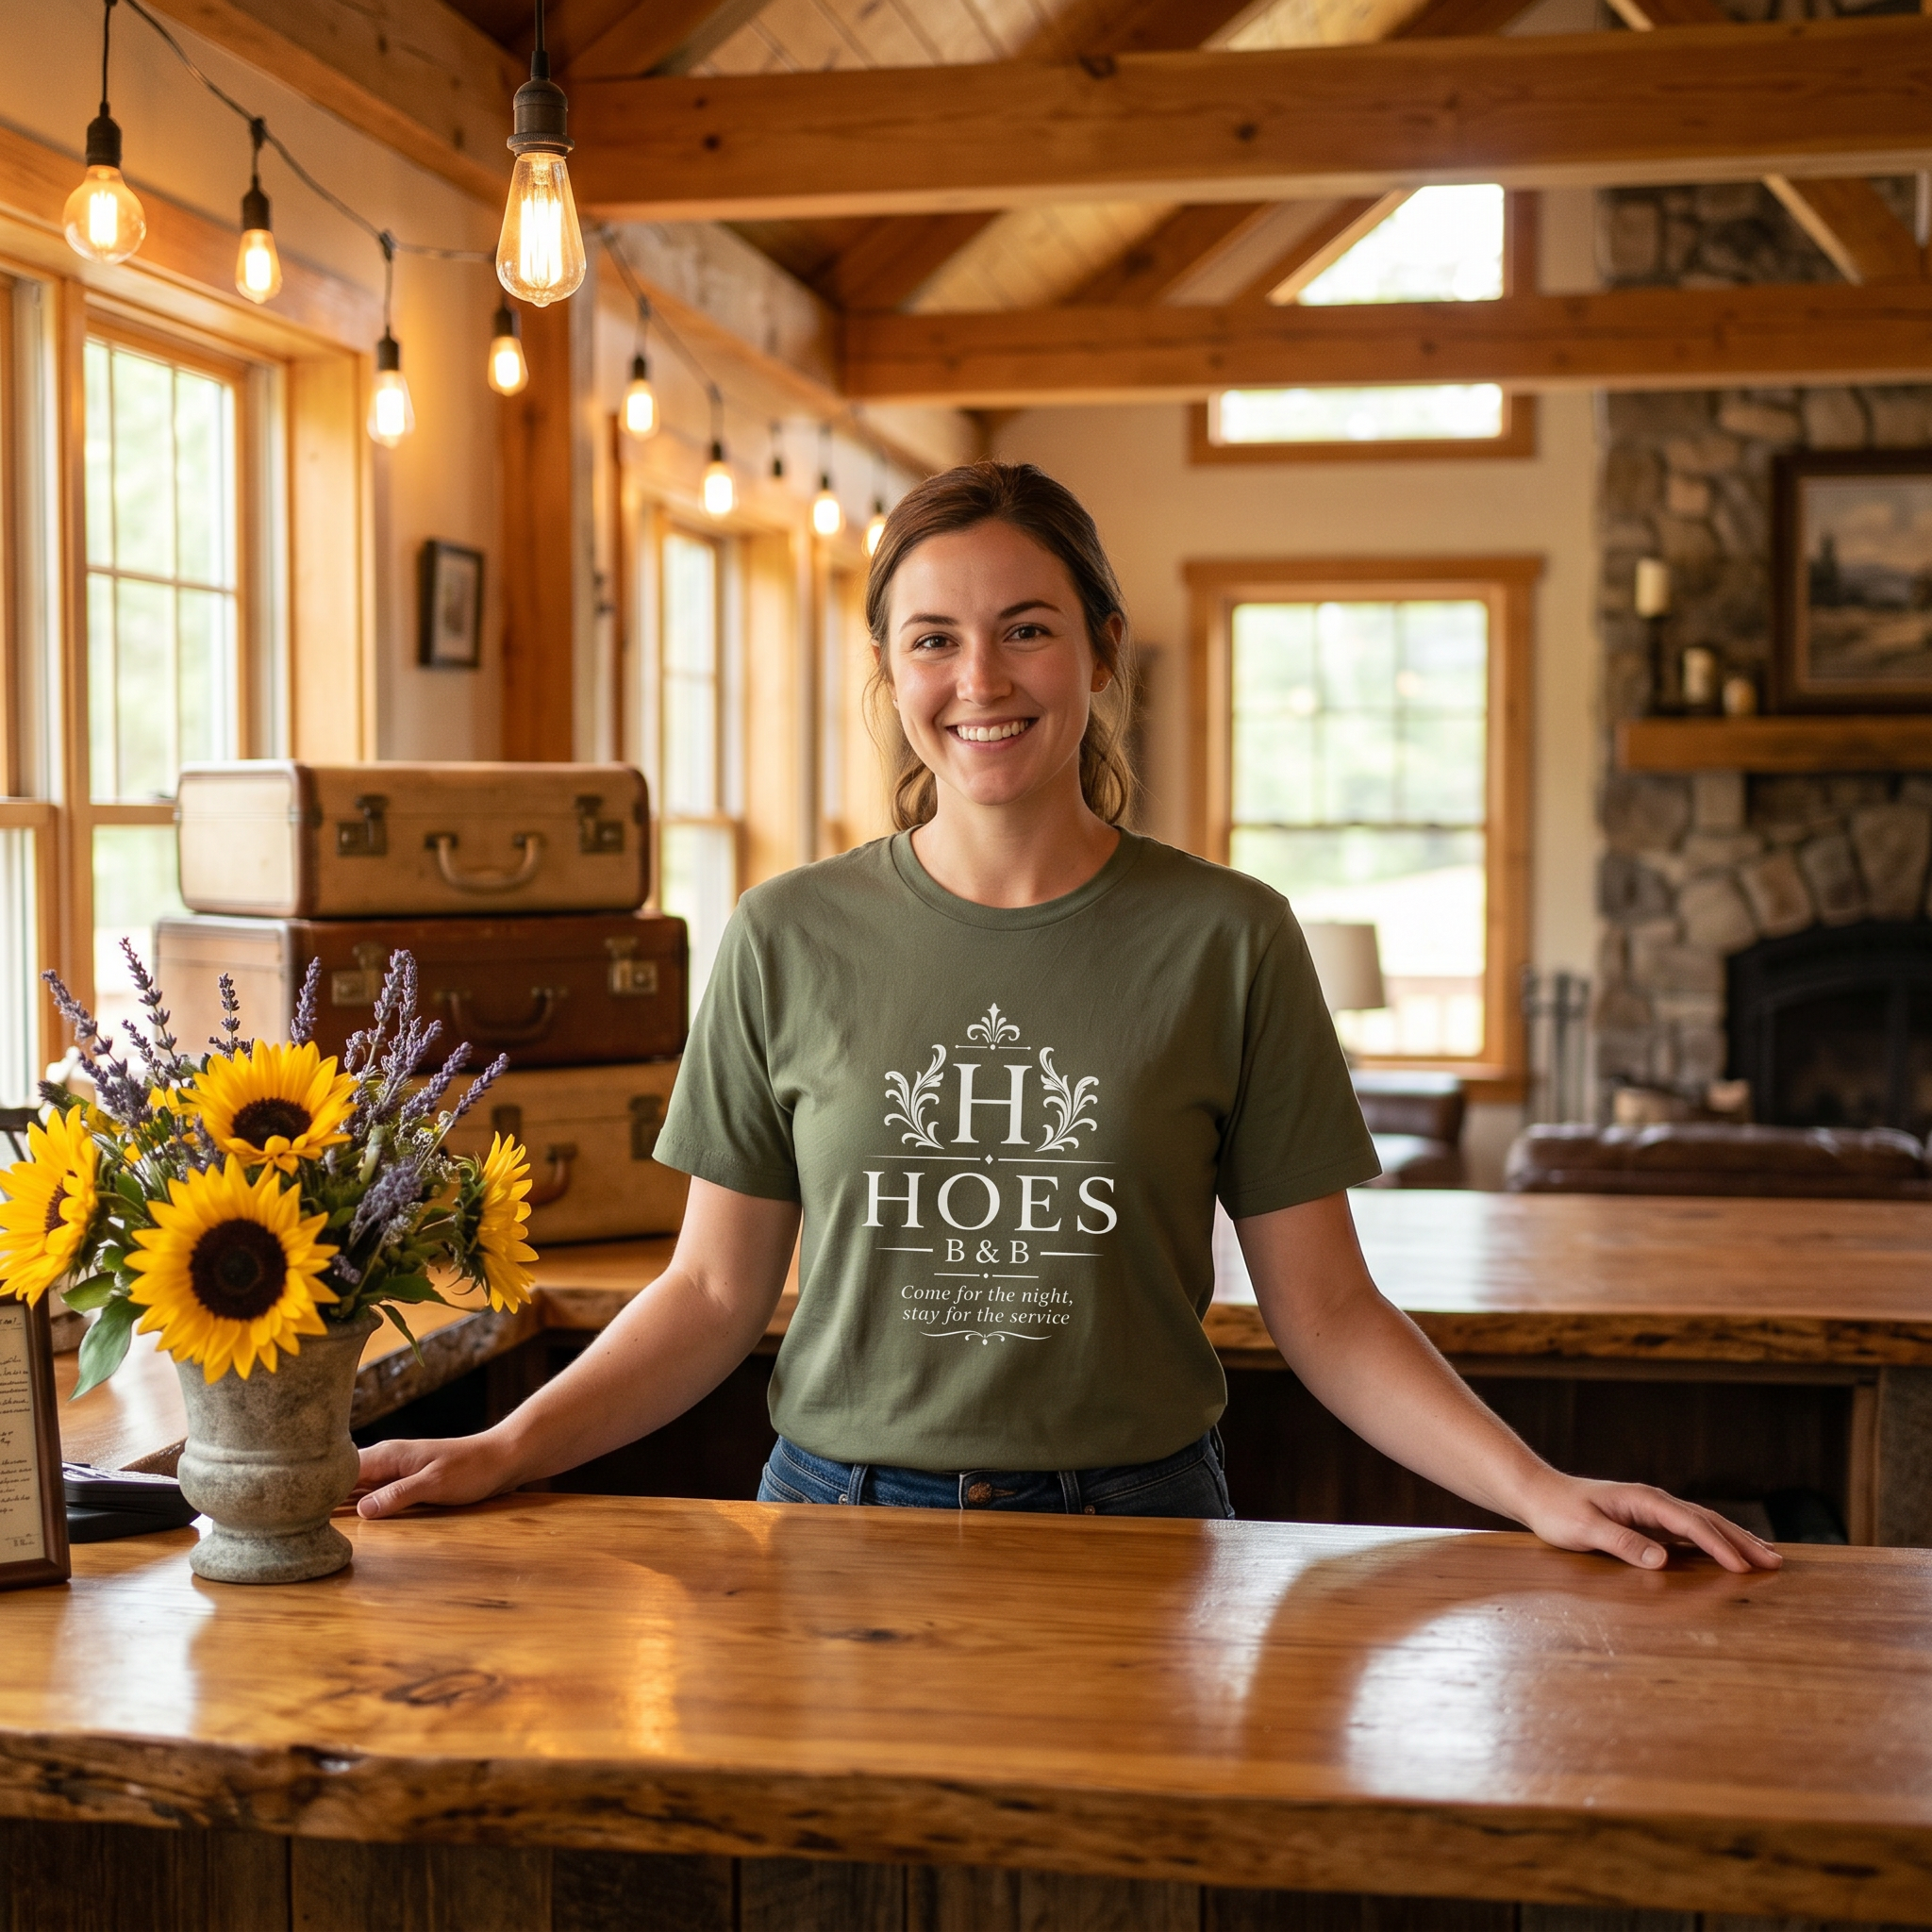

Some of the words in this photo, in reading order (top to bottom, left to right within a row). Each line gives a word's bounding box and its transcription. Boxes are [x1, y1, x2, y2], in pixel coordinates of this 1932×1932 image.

[950, 1063, 1033, 1145] H
[860, 1171, 1119, 1235] HOES
[944, 1238, 966, 1262] B
[975, 1239, 1000, 1264] &
[1008, 1240, 1030, 1264] B
[901, 1285, 950, 1301] Come
[954, 1285, 983, 1305] for
[988, 1286, 1016, 1303] the
[1021, 1288, 1074, 1307] night,
[903, 1307, 941, 1325] stay
[942, 1307, 972, 1325] for
[976, 1307, 1005, 1323] the
[1009, 1309, 1071, 1324] service
